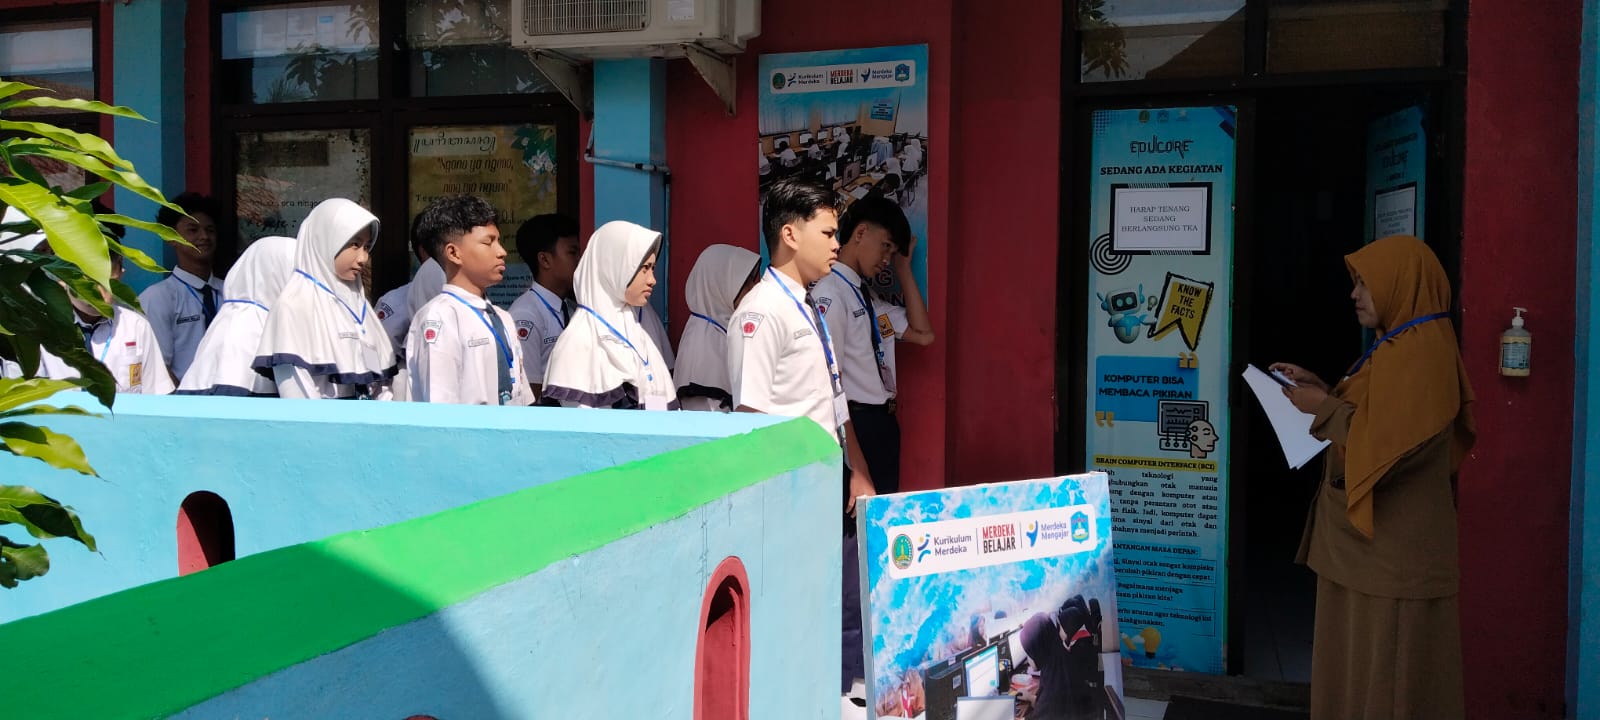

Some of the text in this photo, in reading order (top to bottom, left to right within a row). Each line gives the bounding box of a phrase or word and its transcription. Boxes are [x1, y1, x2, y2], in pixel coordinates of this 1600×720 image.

[831, 76, 853, 85] BELAJAR
[1130, 135, 1194, 159] EDUCORE
[1101, 164, 1223, 176] SEDANG ADA KEGIATAN
[1130, 205, 1157, 213] HARAP
[1121, 225, 1180, 233] BERLANGSUNG
[1177, 283, 1202, 298] KNOW
[1179, 294, 1194, 307] THE
[1169, 304, 1195, 319] FACTS
[1103, 373, 1185, 386] KOMPUTER BISA
[1098, 387, 1193, 399] MEMBACA PIKIRAN
[1096, 457, 1117, 465] BRAIN
[1118, 458, 1158, 468] COMPUTER
[1158, 460, 1197, 470] INTERFACE
[1142, 472, 1175, 481] teknologi
[1162, 491, 1195, 501] komputer
[982, 523, 1016, 540] MERDEKA
[1041, 522, 1067, 533] Merdeka
[933, 534, 973, 547] Kurikulum
[1041, 530, 1070, 541] Mengajar
[934, 545, 968, 557] Merdeka
[983, 537, 1017, 554] BELAJAR
